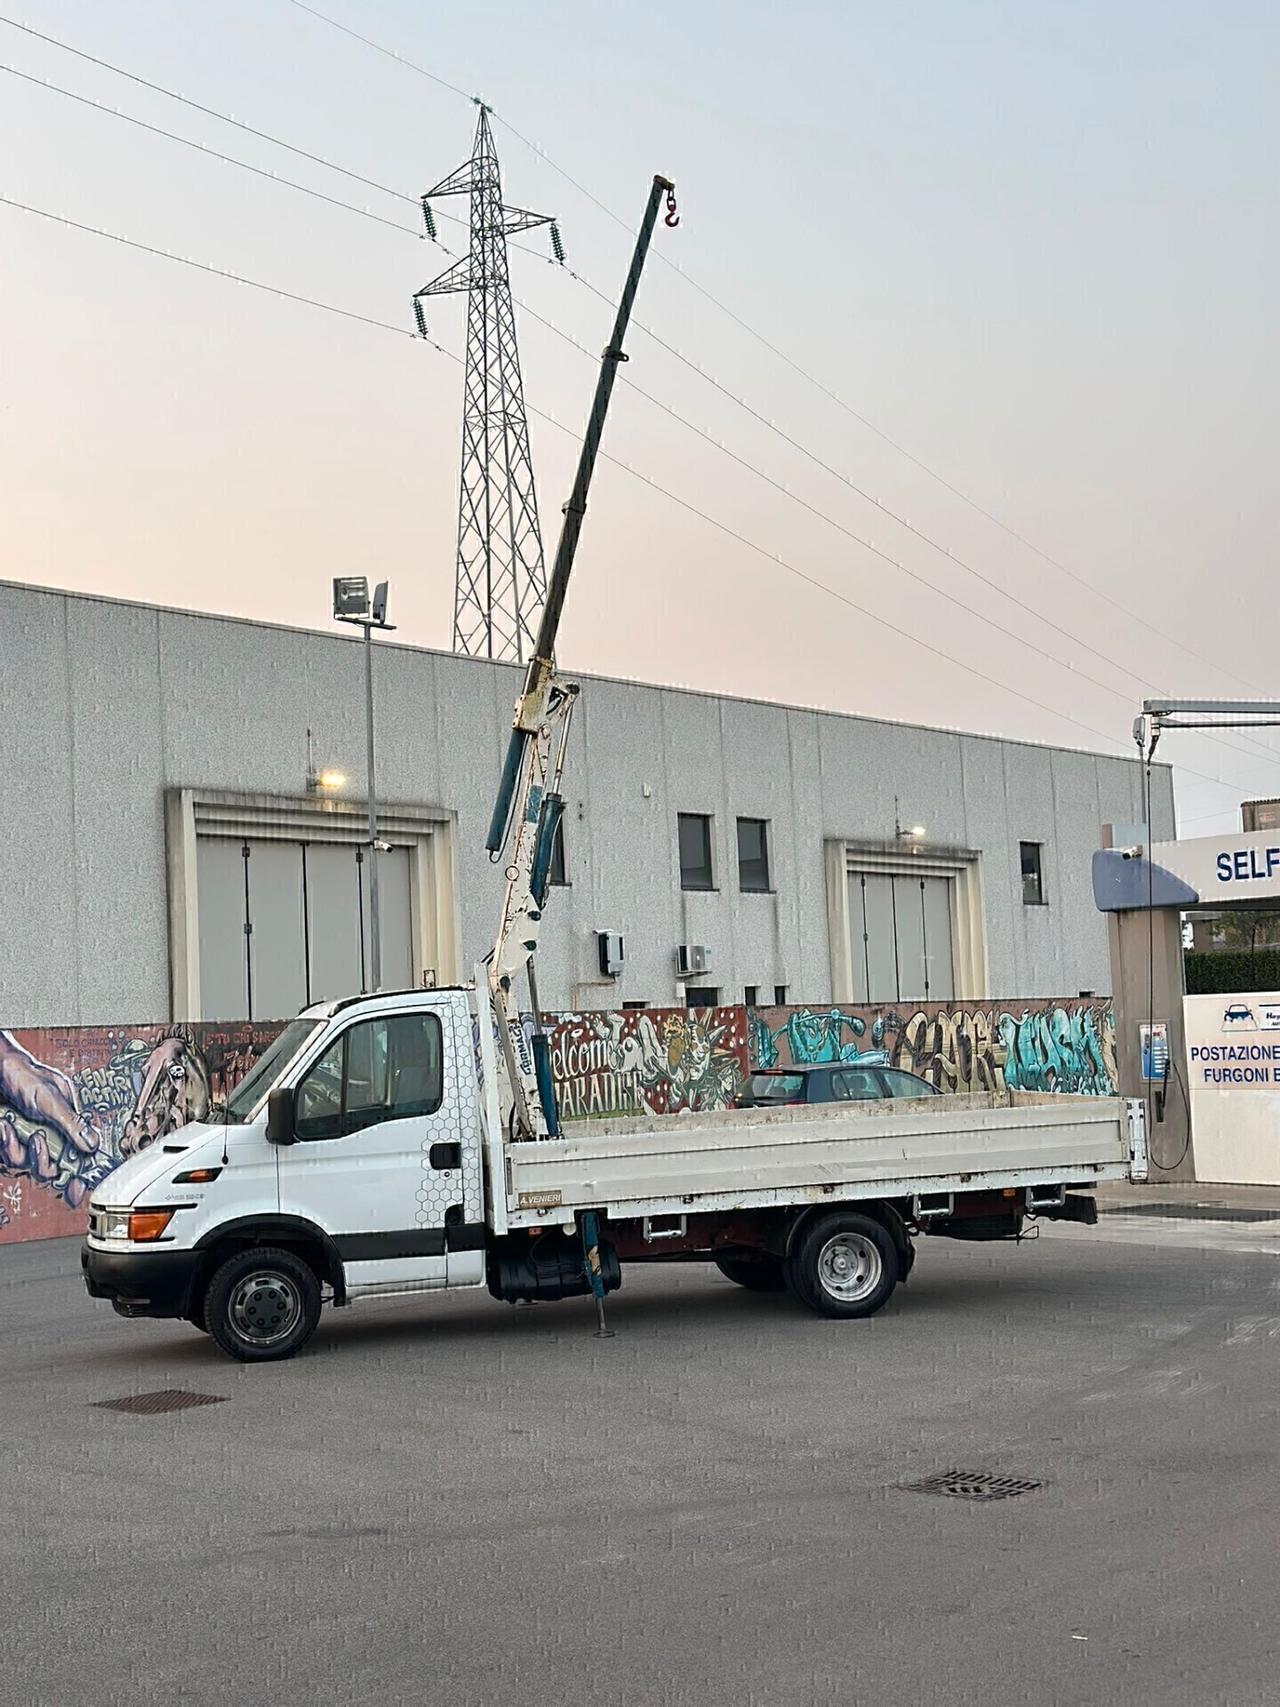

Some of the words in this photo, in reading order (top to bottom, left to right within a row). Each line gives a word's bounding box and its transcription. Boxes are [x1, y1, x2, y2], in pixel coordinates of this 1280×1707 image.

[1217, 848, 1280, 882] SELF
[548, 1030, 618, 1080] elcome
[1191, 1046, 1280, 1061] POSTAZIONE
[1204, 1067, 1269, 1082] FURGONI
